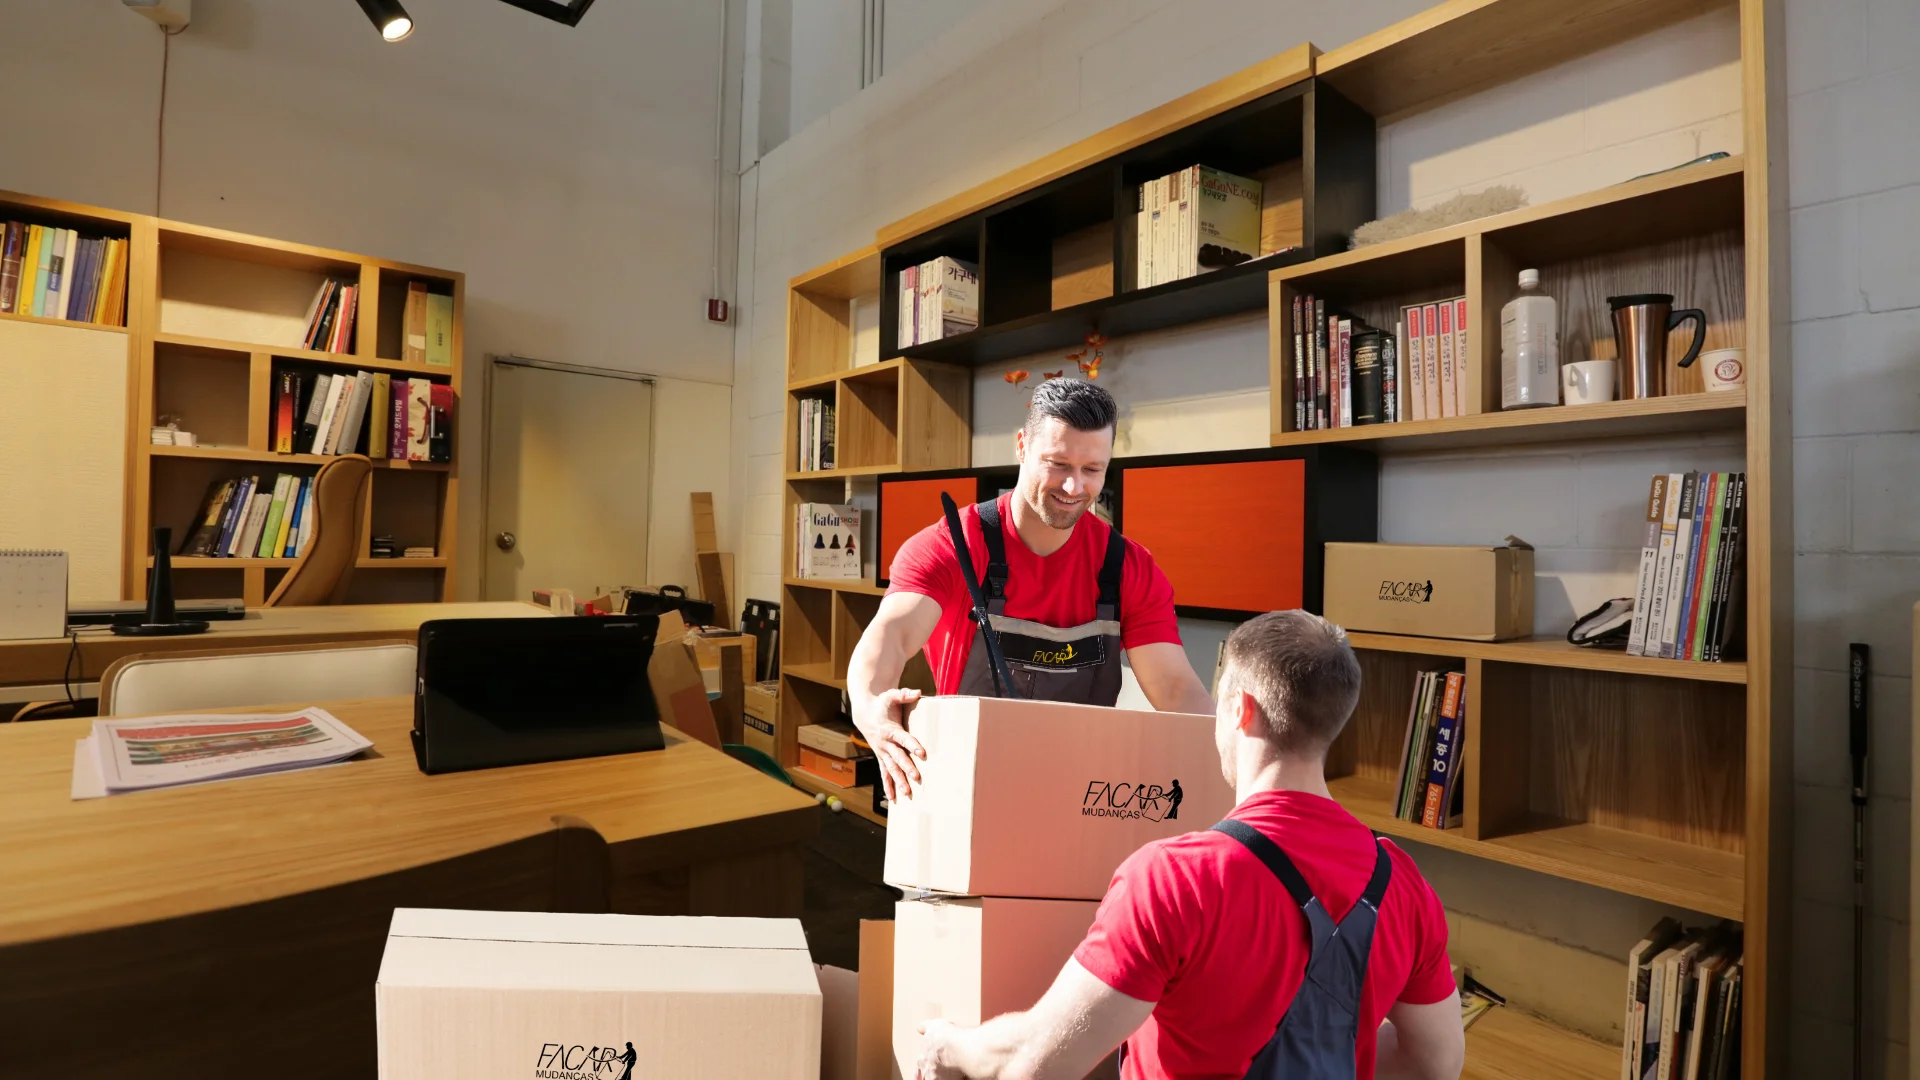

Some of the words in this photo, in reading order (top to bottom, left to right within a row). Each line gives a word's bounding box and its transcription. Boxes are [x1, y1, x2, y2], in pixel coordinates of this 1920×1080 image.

[1379, 581, 1422, 596] FACAR
[1032, 650, 1066, 664] FACAR
[1853, 660, 1862, 709] ODYSSEY
[1083, 781, 1163, 810] FACAR
[1424, 787, 1438, 825] 765-1837
[1082, 808, 1140, 820] MUDANÇAS
[537, 1044, 616, 1072] FACAR
